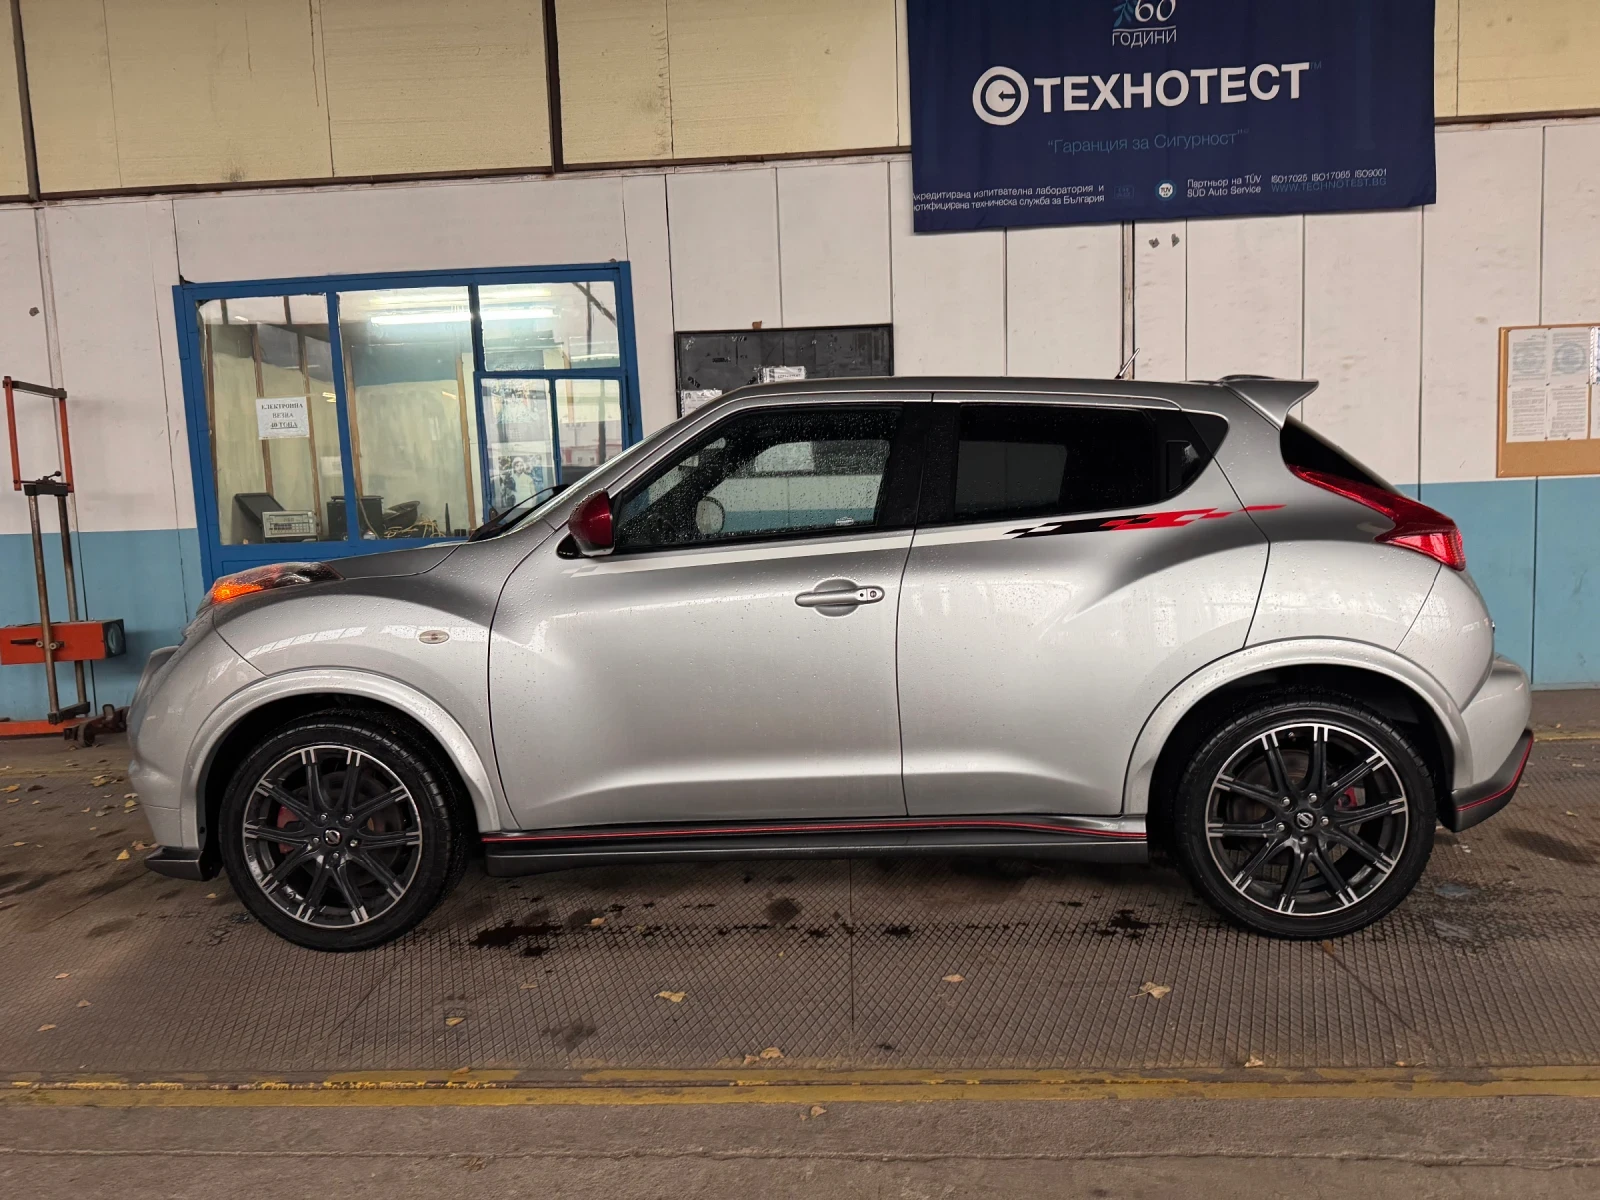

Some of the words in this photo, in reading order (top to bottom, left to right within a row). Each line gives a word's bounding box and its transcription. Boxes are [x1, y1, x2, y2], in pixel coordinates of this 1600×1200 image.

[1134, 0, 1176, 22] 60
[1112, 28, 1177, 49] ГОДИНИ
[1033, 61, 1310, 113] ТЕХНОТЕСТ
[1132, 138, 1149, 150] за
[1187, 178, 1229, 189] Партньор
[1231, 176, 1242, 185] на
[1244, 173, 1262, 184] TÜV
[1271, 177, 1387, 192] WWW.TECHNOTEST.BG
[973, 187, 1033, 199] изпитвателна
[1035, 184, 1094, 196] лаборатория
[1098, 184, 1104, 192] и
[1187, 187, 1206, 198] SÜD
[1208, 186, 1228, 196] Auto
[1230, 185, 1262, 195] Service
[971, 197, 1018, 210] техническа
[1019, 196, 1051, 207] служба
[1051, 197, 1062, 205] за
[1063, 194, 1105, 205] България
